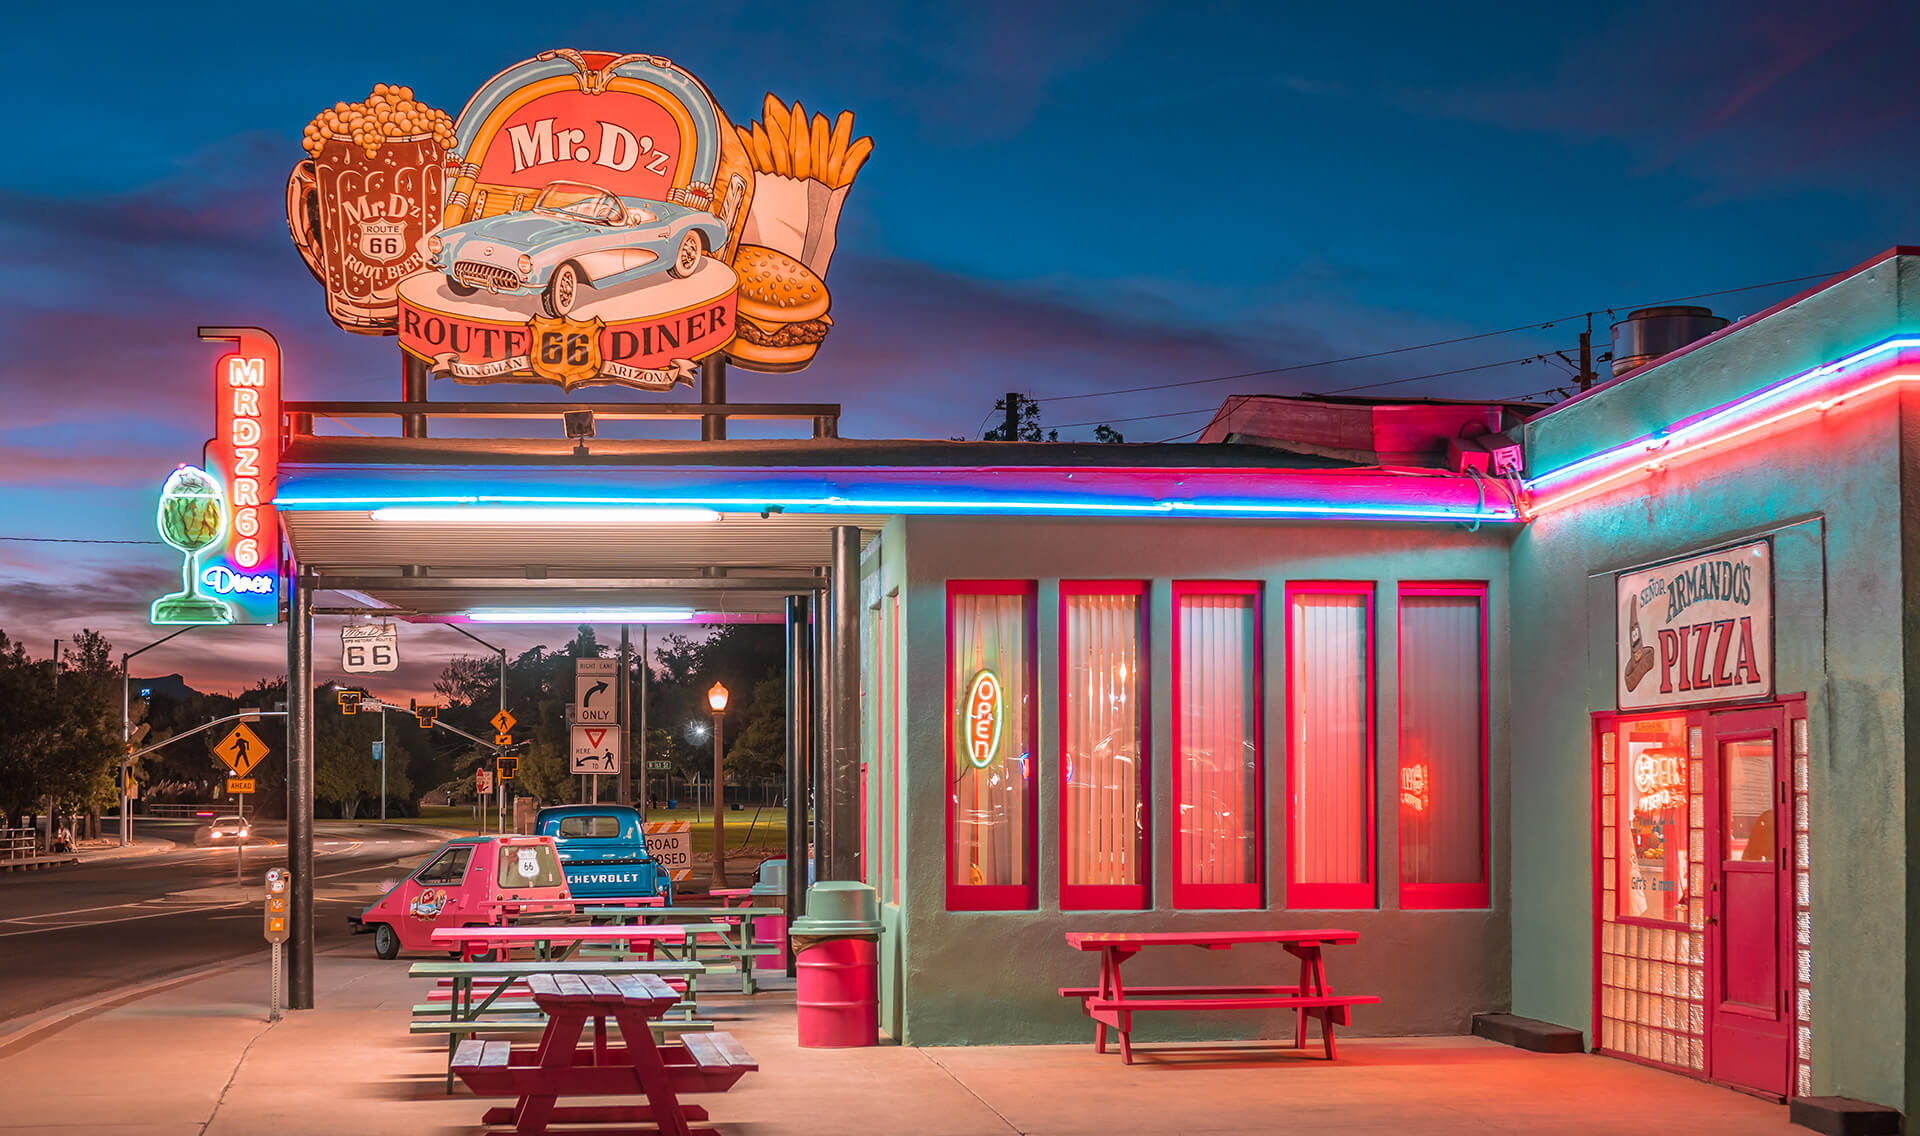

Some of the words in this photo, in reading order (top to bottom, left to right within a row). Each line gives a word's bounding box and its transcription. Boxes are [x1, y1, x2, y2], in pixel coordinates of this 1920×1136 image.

[505, 117, 591, 174] Mr.
[592, 120, 671, 177] D'z
[342, 194, 386, 225] Mr.
[387, 192, 421, 218] D'z
[366, 225, 399, 233] ROUTE
[370, 237, 397, 254] 66
[344, 253, 384, 280] ROOT
[386, 251, 423, 280] BEER
[403, 306, 526, 359] ROUTE
[541, 331, 590, 366] 66
[611, 305, 728, 361] DINER
[454, 357, 524, 377] KINGMAN
[607, 361, 674, 384] ARIZONA
[202, 566, 273, 594] Diner
[1639, 578, 1667, 608] SEÑOR
[1665, 560, 1751, 624] ARMANDO'S
[347, 645, 391, 666] 66
[1657, 616, 1761, 694] PIZZA
[582, 710, 610, 720] ONLY
[647, 838, 679, 850] ROAD
[523, 862, 534, 871] 66
[567, 873, 639, 884] CHEVROLET
